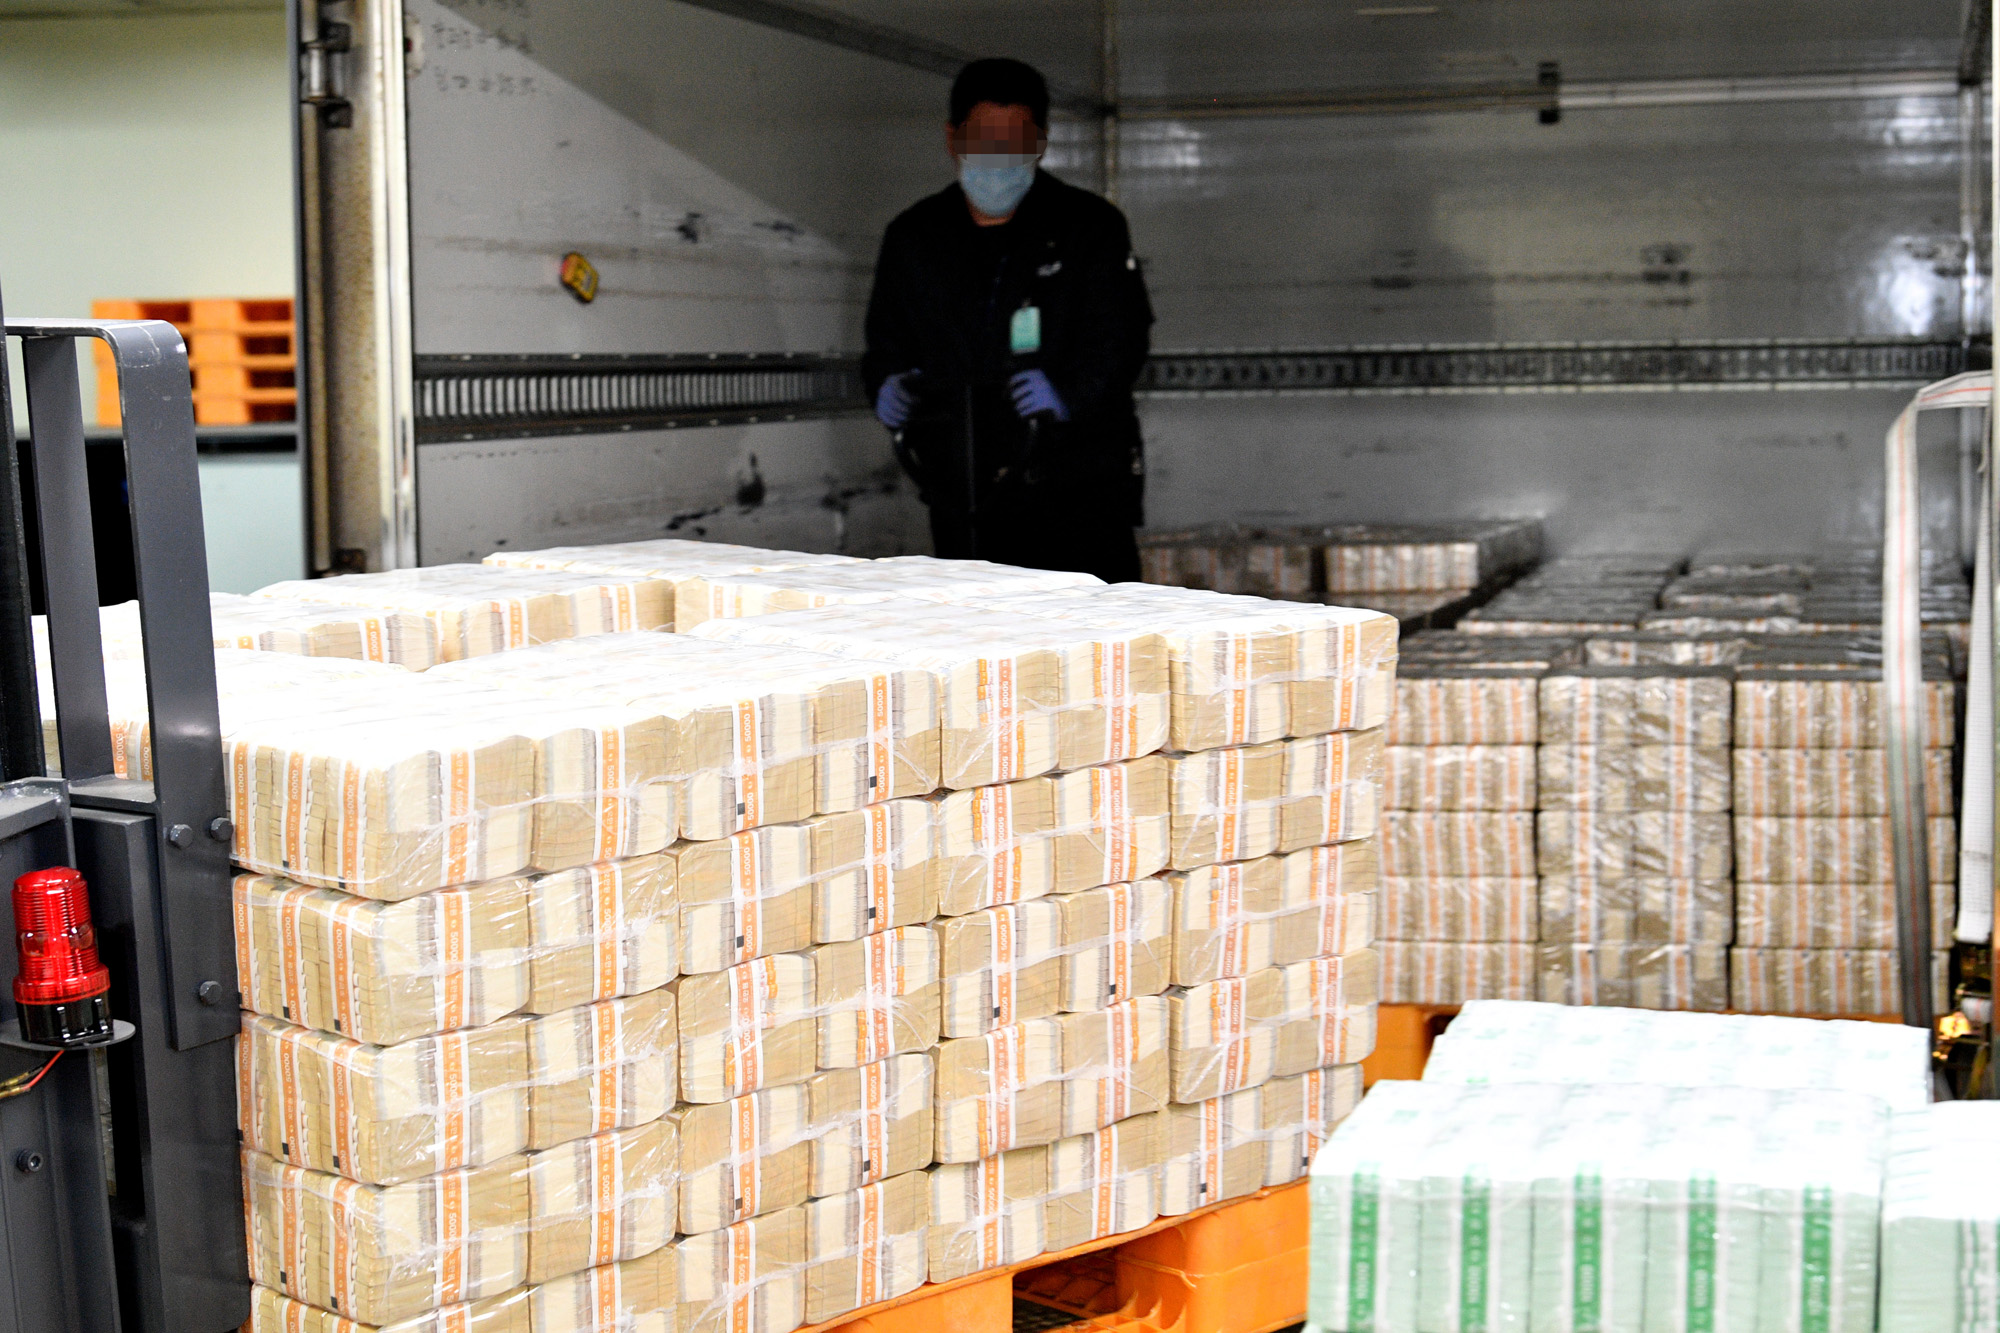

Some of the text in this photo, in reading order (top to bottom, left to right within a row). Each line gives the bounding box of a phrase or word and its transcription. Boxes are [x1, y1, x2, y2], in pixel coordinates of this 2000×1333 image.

[876, 689, 886, 793] 50000 50000
[744, 713, 755, 820] 50000 50000
[291, 769, 299, 799] 50000
[237, 903, 246, 933] 50000
[877, 897, 885, 924] 50000
[285, 916, 293, 946] 50000
[335, 928, 344, 960] 50000
[745, 925, 754, 953] 50000
[450, 932, 459, 962] 50000
[283, 1052, 292, 1082] 50000
[742, 1110, 752, 1214] 50000 50000
